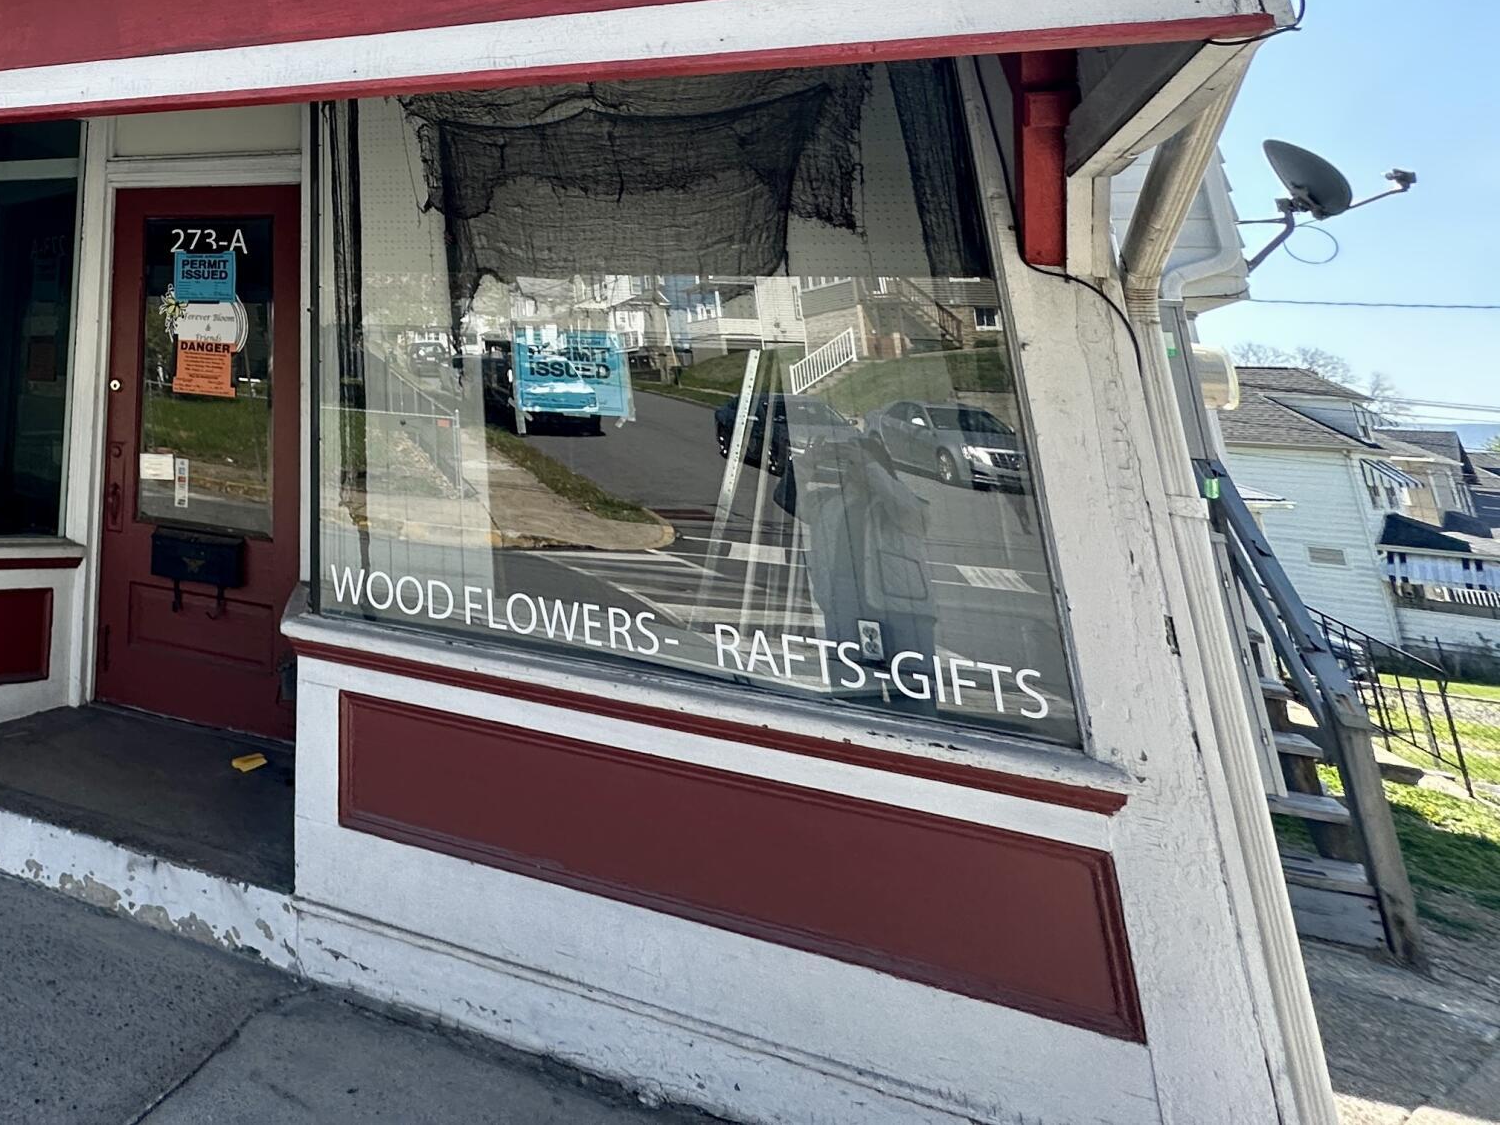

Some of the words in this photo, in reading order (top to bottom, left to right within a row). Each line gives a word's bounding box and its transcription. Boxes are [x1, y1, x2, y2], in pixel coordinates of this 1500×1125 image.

[170, 228, 248, 254] 273-A
[181, 259, 229, 270] PERMIT
[181, 270, 229, 280] ISSUED
[180, 341, 231, 353] DANGER
[529, 361, 611, 379] ISSUED
[331, 564, 454, 620] WOOD
[464, 586, 679, 655] FLOWERS-
[714, 623, 1049, 719] RAFTS-GIFTS
